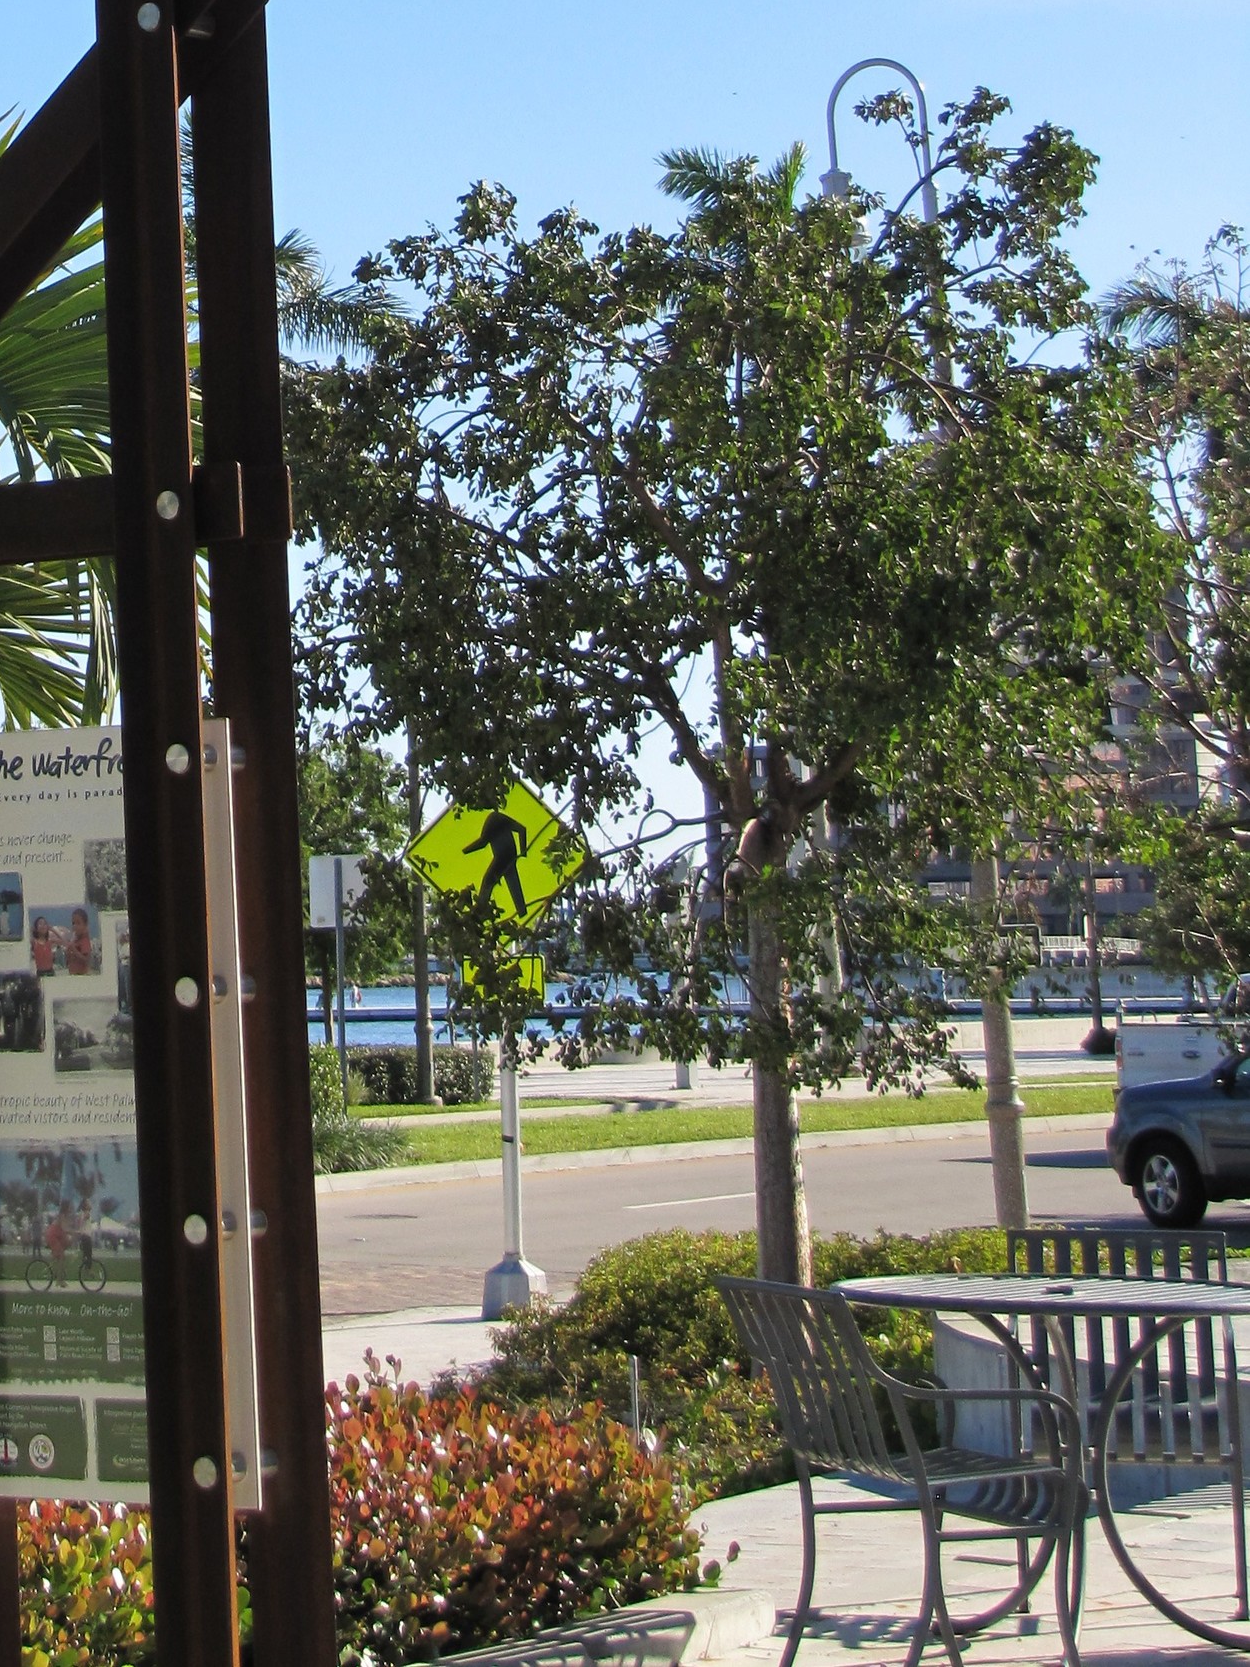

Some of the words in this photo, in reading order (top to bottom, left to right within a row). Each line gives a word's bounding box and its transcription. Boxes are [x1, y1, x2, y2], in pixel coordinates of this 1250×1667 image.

[39, 789, 61, 801] day
[67, 788, 78, 799] is
[7, 835, 35, 847] never
[2, 851, 22, 865] and
[33, 1091, 69, 1111] beauty
[70, 1092, 84, 1108] of
[85, 1092, 109, 1108] West
[70, 1110, 92, 1125] and
[12, 1302, 33, 1315] More
[35, 1303, 47, 1316] to
